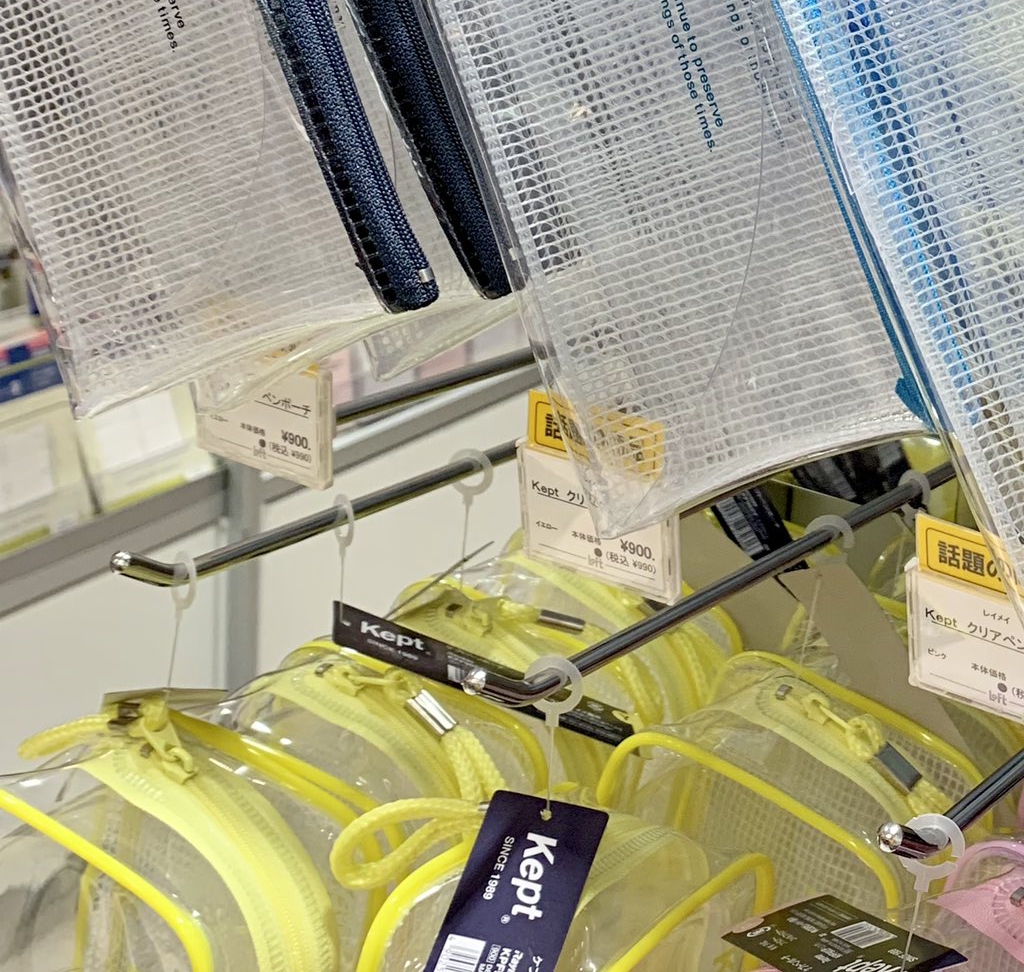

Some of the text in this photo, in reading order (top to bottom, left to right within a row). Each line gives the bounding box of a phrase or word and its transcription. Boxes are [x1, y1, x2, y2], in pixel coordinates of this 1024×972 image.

[157, 5, 179, 54] times.
[671, 33, 685, 50] of
[686, 35, 698, 53] to
[677, 53, 698, 100] those
[691, 57, 724, 128] preserve
[694, 102, 716, 153] times.
[262, 392, 312, 416] ペンポーチ
[531, 480, 559, 498] Kept
[535, 519, 558, 531] イエロー
[571, 530, 602, 546] 本体価格
[605, 551, 657, 575] (税込 ¥990)
[925, 607, 958, 629] Kept
[983, 608, 1011, 625] レイメイ
[360, 620, 425, 652] Kept
[927, 648, 948, 661] ピンク
[970, 662, 1008, 681] 本体価格
[482, 835, 515, 901] SINCE 1989
[511, 832, 558, 921] Kept
